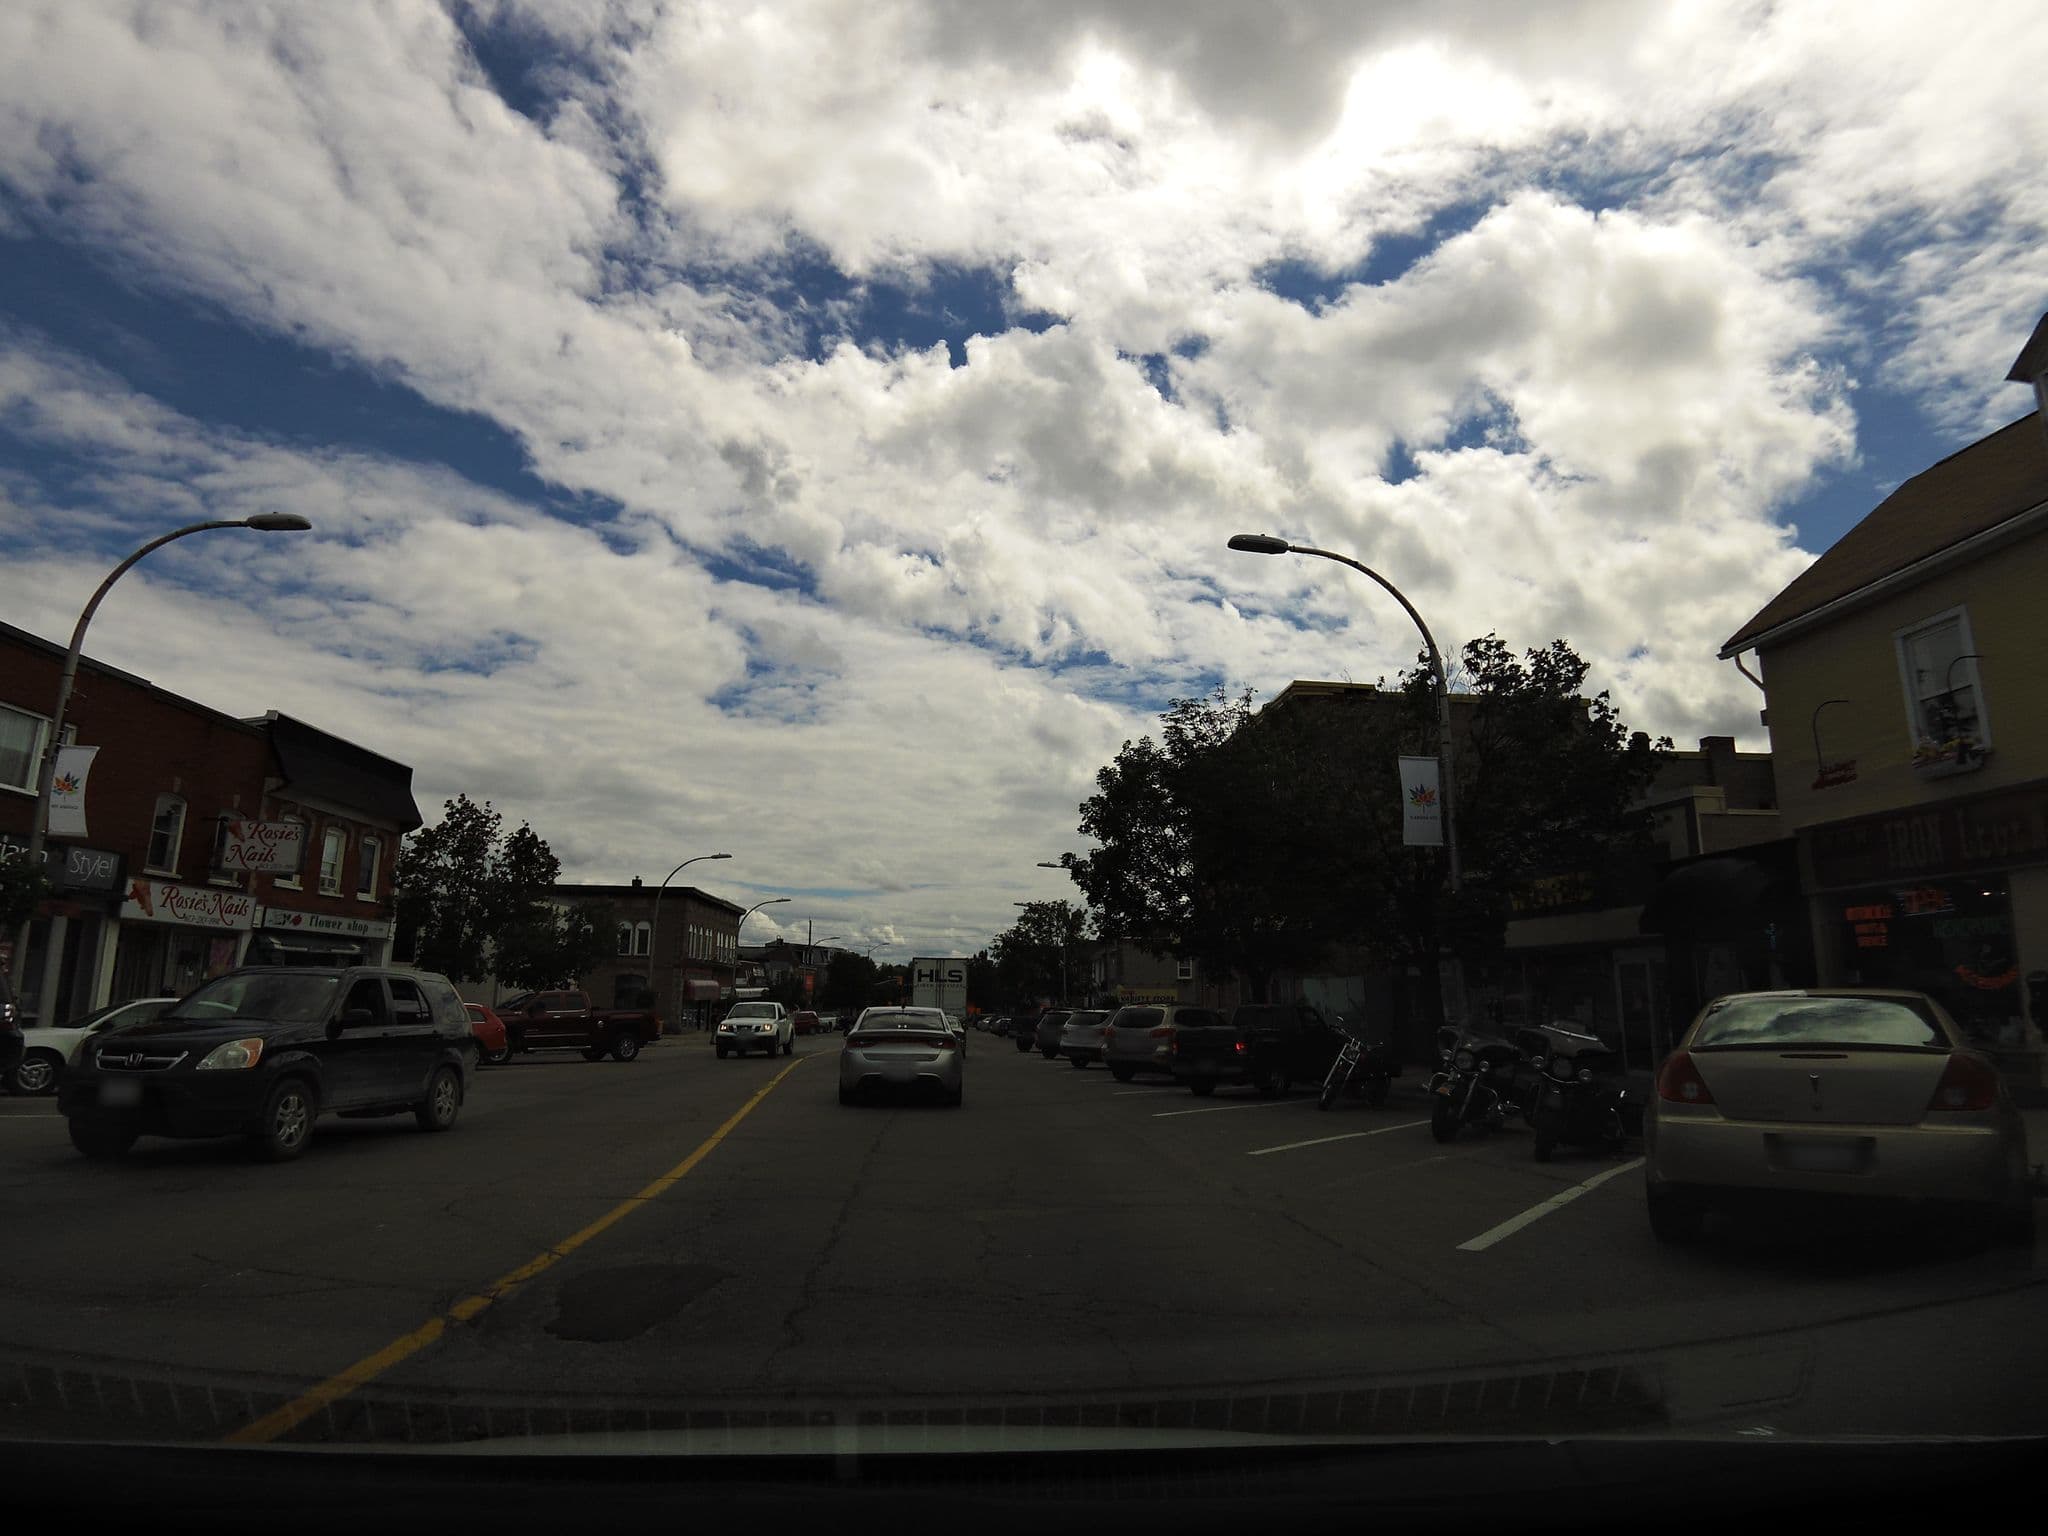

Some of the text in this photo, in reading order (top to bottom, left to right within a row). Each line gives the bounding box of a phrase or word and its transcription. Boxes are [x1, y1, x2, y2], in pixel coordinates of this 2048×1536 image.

[248, 822, 301, 848] Rosie's
[70, 850, 114, 882] Style!
[225, 844, 277, 871] Nails
[160, 885, 207, 919] Rosie's
[207, 893, 249, 926] Nails
[917, 969, 963, 983] HLS
